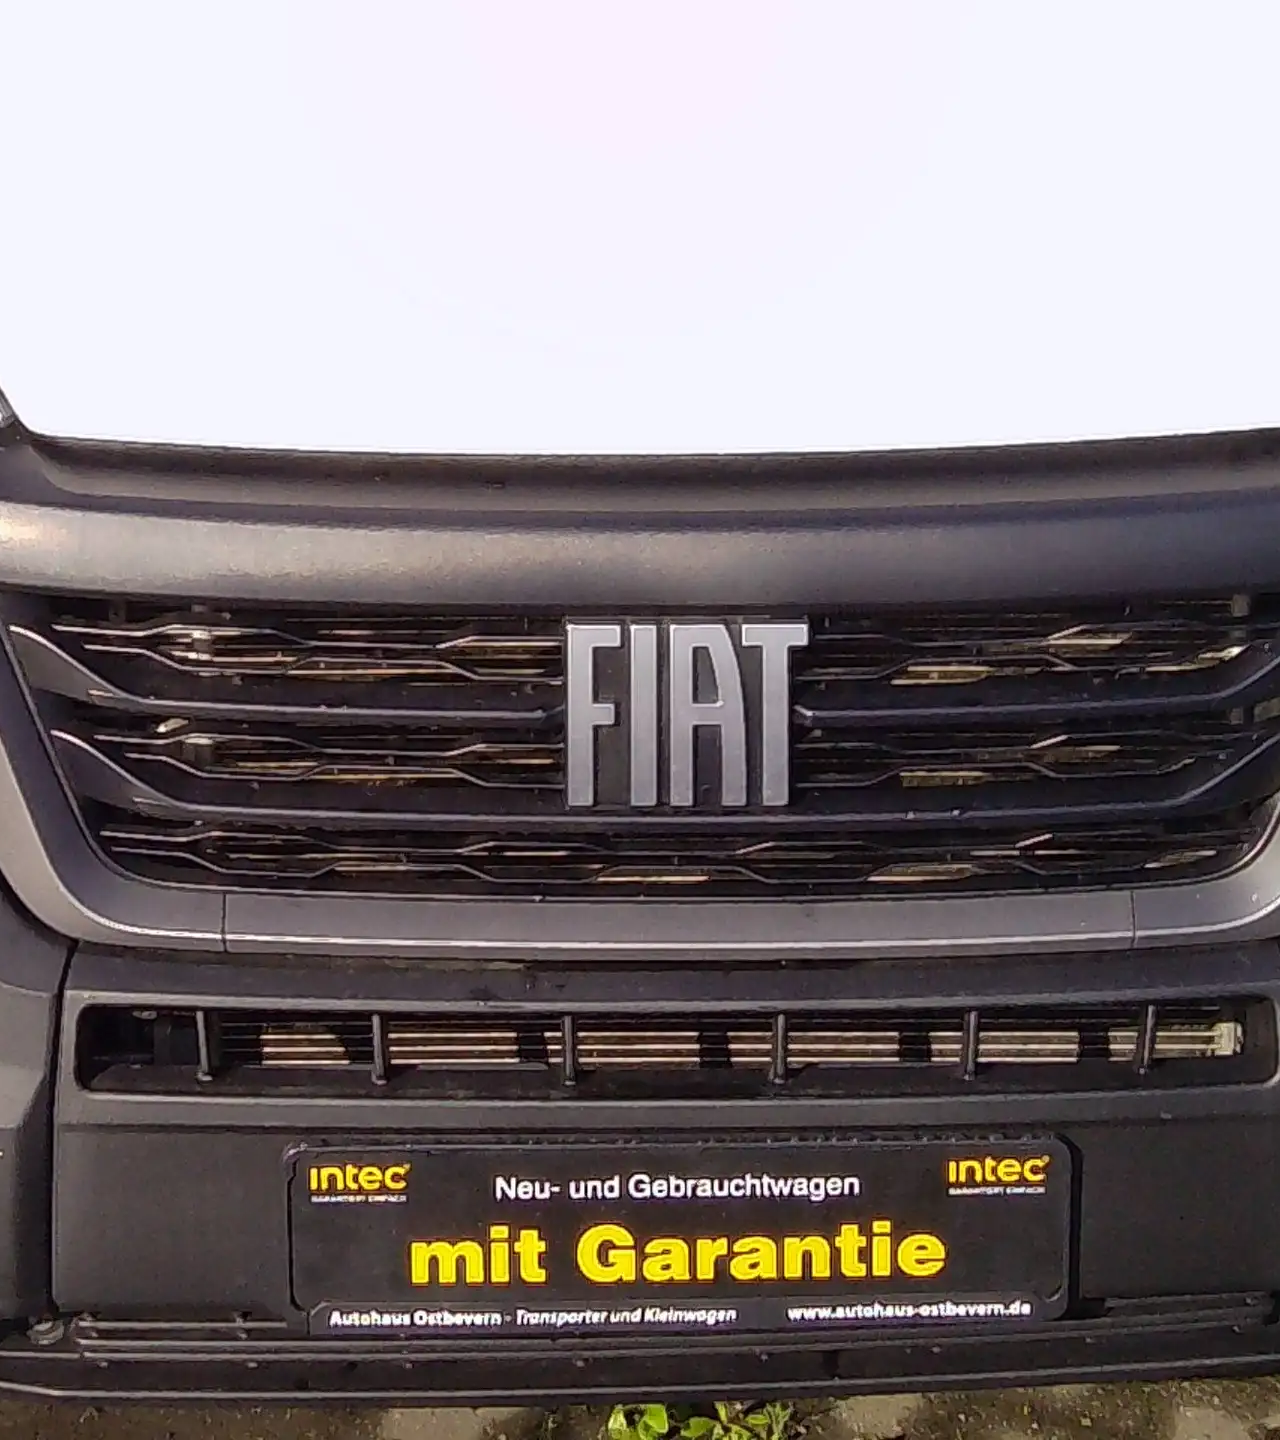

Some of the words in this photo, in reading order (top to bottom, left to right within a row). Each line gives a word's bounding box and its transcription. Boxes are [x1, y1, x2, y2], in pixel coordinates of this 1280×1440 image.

[566, 623, 809, 807] FIAT
[309, 1163, 408, 1191] intec
[948, 1155, 1046, 1183] intec
[494, 1176, 561, 1200] Neu-
[569, 1175, 620, 1199] und
[628, 1173, 861, 1201] Gebrauchtwagen
[411, 1225, 547, 1284] mit
[576, 1220, 948, 1283] Garantie
[329, 1311, 411, 1327] Autohaus
[413, 1310, 502, 1326] Ostbevern
[516, 1309, 608, 1327] Transporter
[610, 1309, 641, 1324] und
[644, 1307, 737, 1325] Kleinwagen
[787, 1300, 1031, 1321] www.autohaus-ostbevern.de
